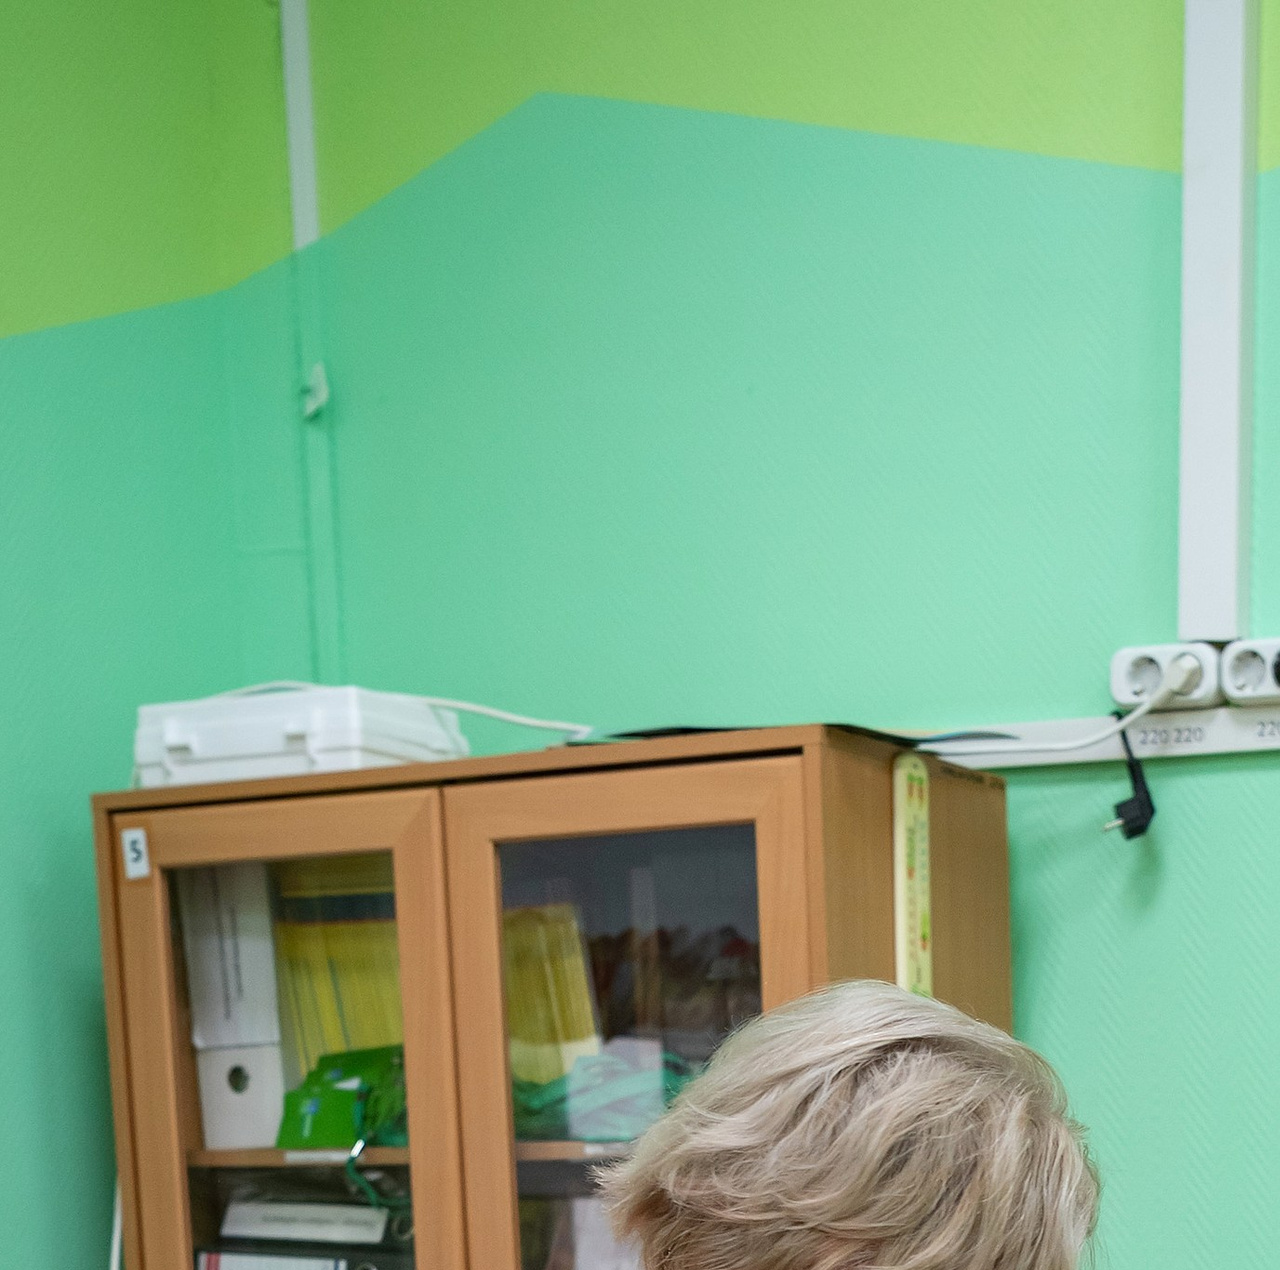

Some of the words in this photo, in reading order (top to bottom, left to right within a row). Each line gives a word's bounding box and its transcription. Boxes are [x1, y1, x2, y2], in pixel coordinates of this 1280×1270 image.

[1140, 729, 1169, 745] 220
[1174, 726, 1204, 743] 220
[129, 839, 143, 863] 5
